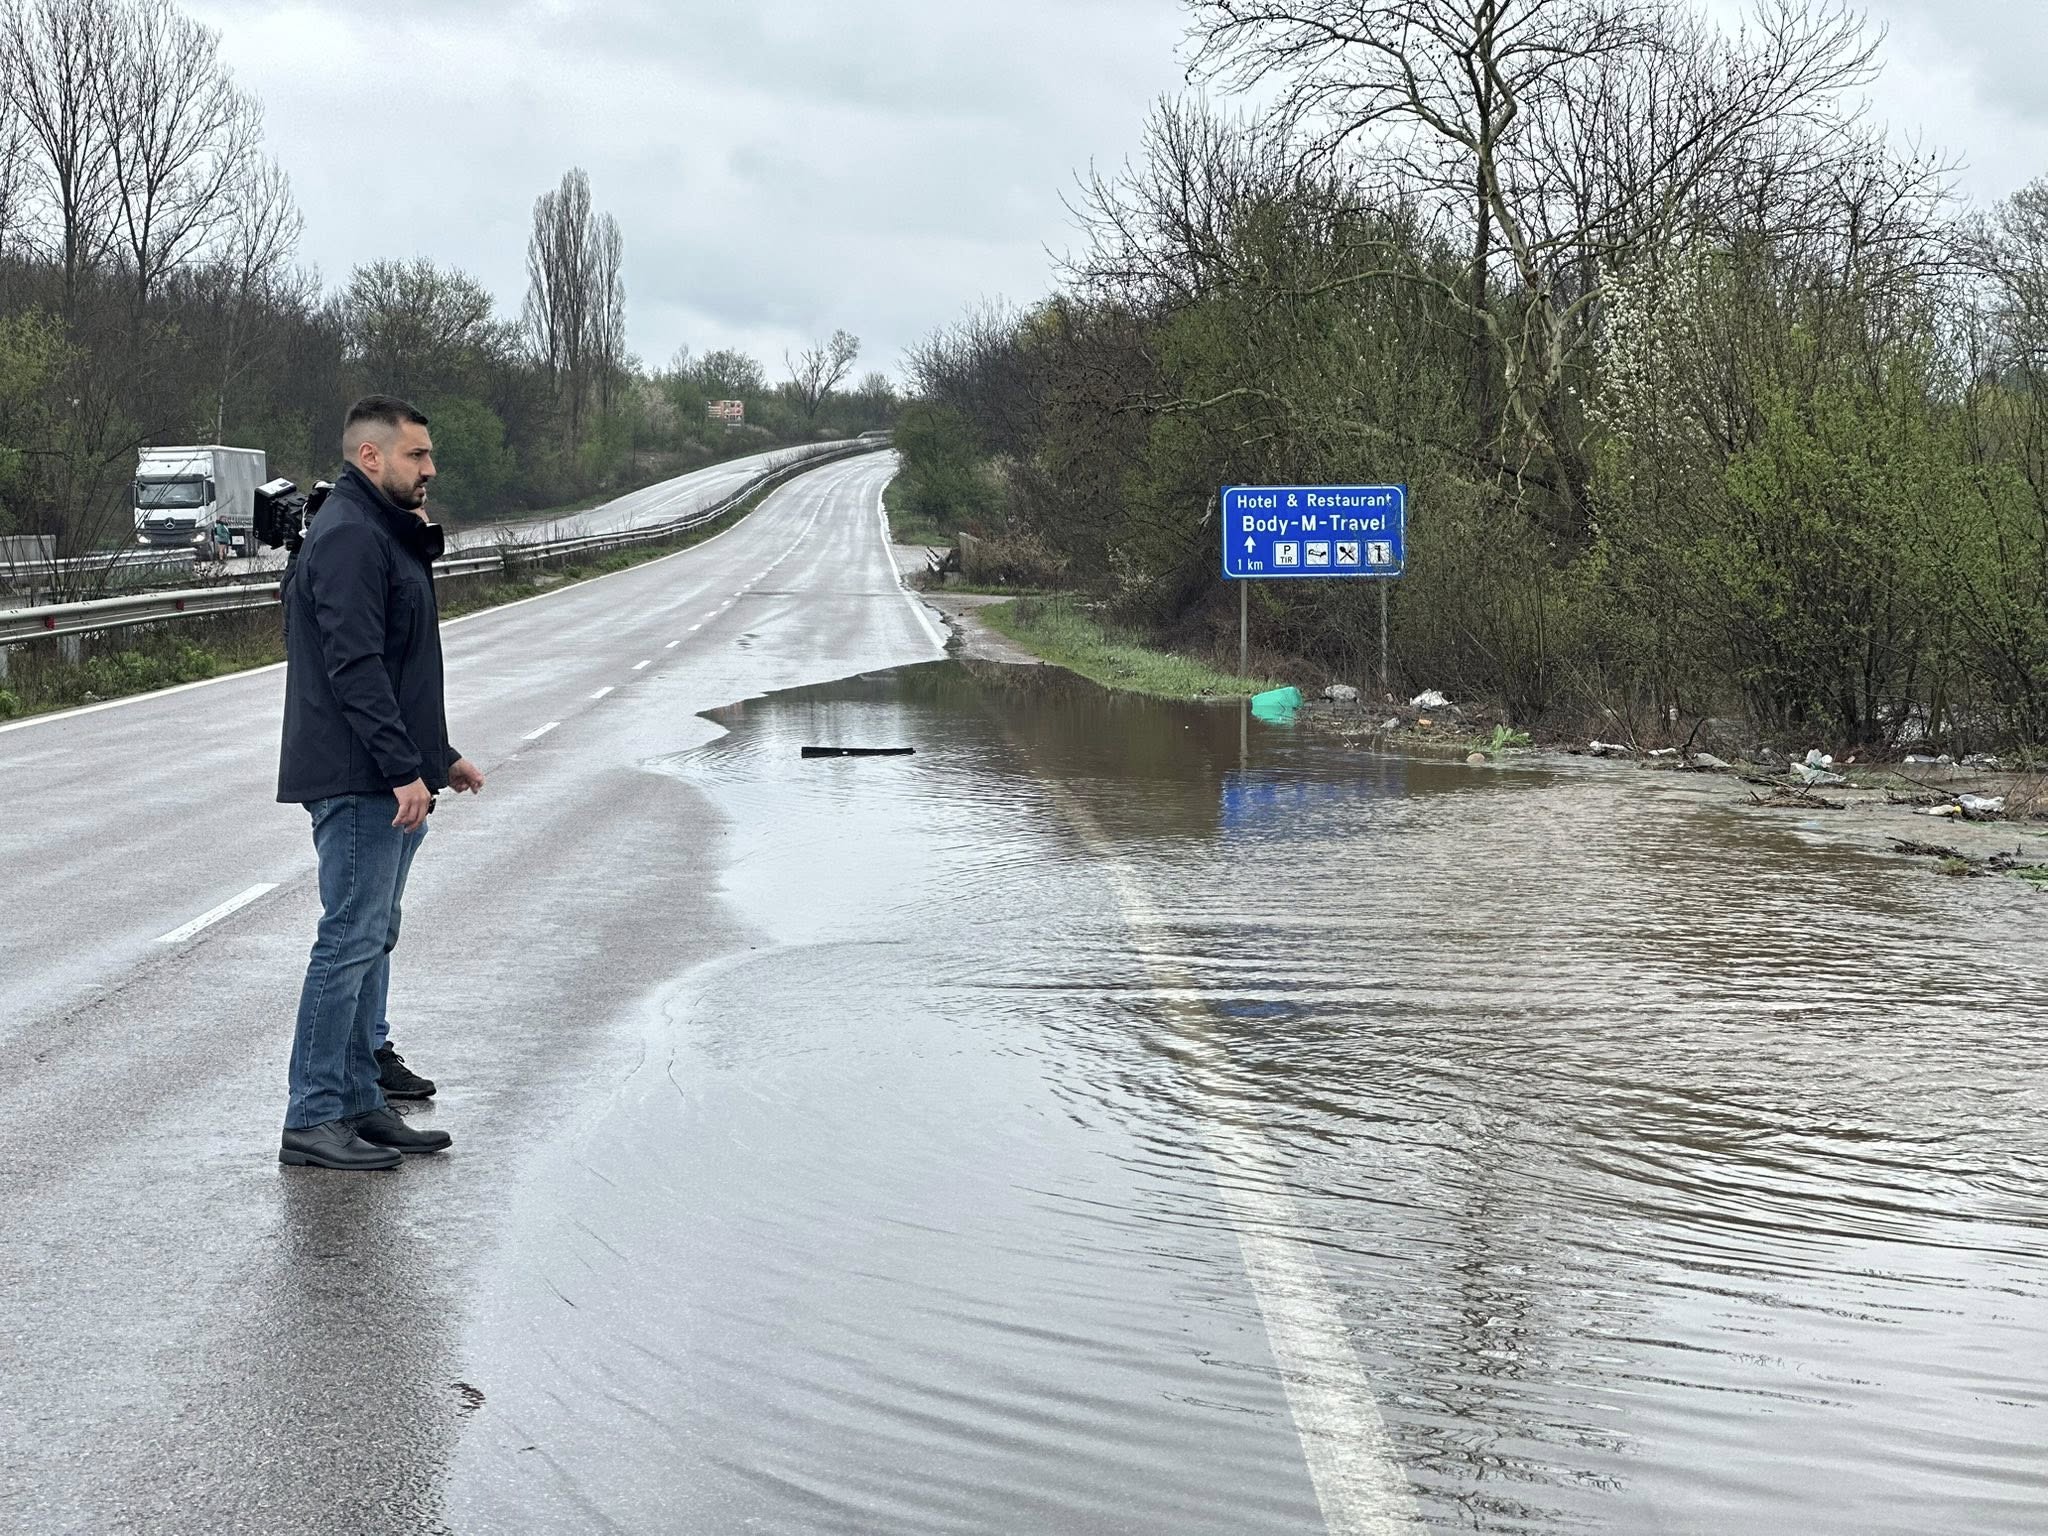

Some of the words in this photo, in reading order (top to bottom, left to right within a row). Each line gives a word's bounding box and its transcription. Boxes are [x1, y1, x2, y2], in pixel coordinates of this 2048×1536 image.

[1237, 494, 1277, 509] Hotel
[1286, 493, 1298, 507] &
[1307, 493, 1392, 507] Restaurant
[1242, 514, 1386, 536] Body-M-Travel
[1283, 544, 1291, 555] P
[1237, 559, 1242, 571] 1
[1247, 558, 1264, 571] km
[1280, 556, 1293, 564] TIR
